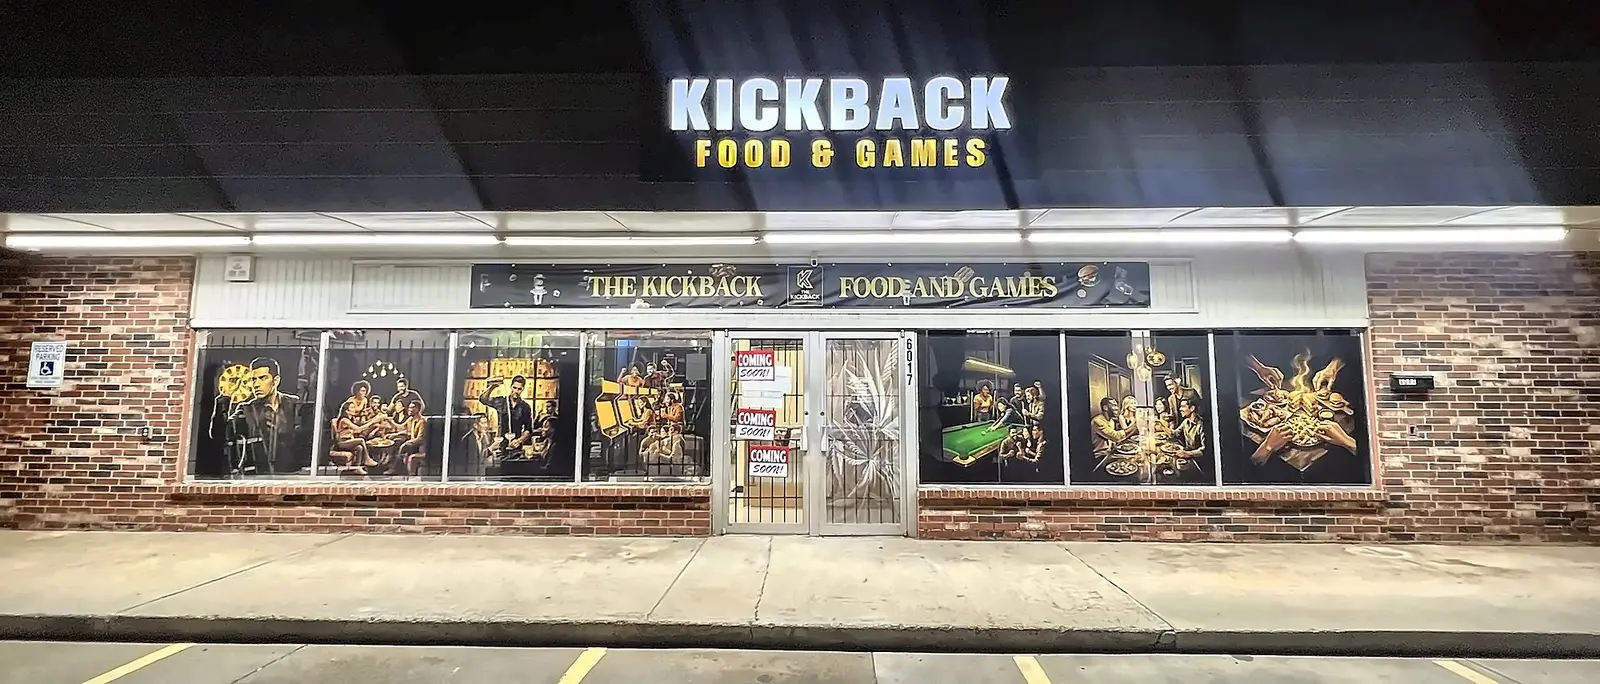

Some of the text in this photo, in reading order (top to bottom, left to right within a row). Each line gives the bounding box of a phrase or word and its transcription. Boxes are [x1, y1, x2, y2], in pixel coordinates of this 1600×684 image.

[669, 77, 1012, 132] KICKBACK
[695, 138, 987, 168] FOOD & GAMES
[588, 274, 763, 298] THE KICKBACK
[838, 274, 1058, 299] FOOD AND GAMES
[34, 344, 64, 352] RESERVED
[738, 354, 773, 367] COMING
[740, 368, 770, 378] SOON!
[738, 411, 774, 426] COMING
[739, 426, 771, 437] SOON!
[751, 449, 787, 463] COMING
[753, 462, 784, 474] SOON!
